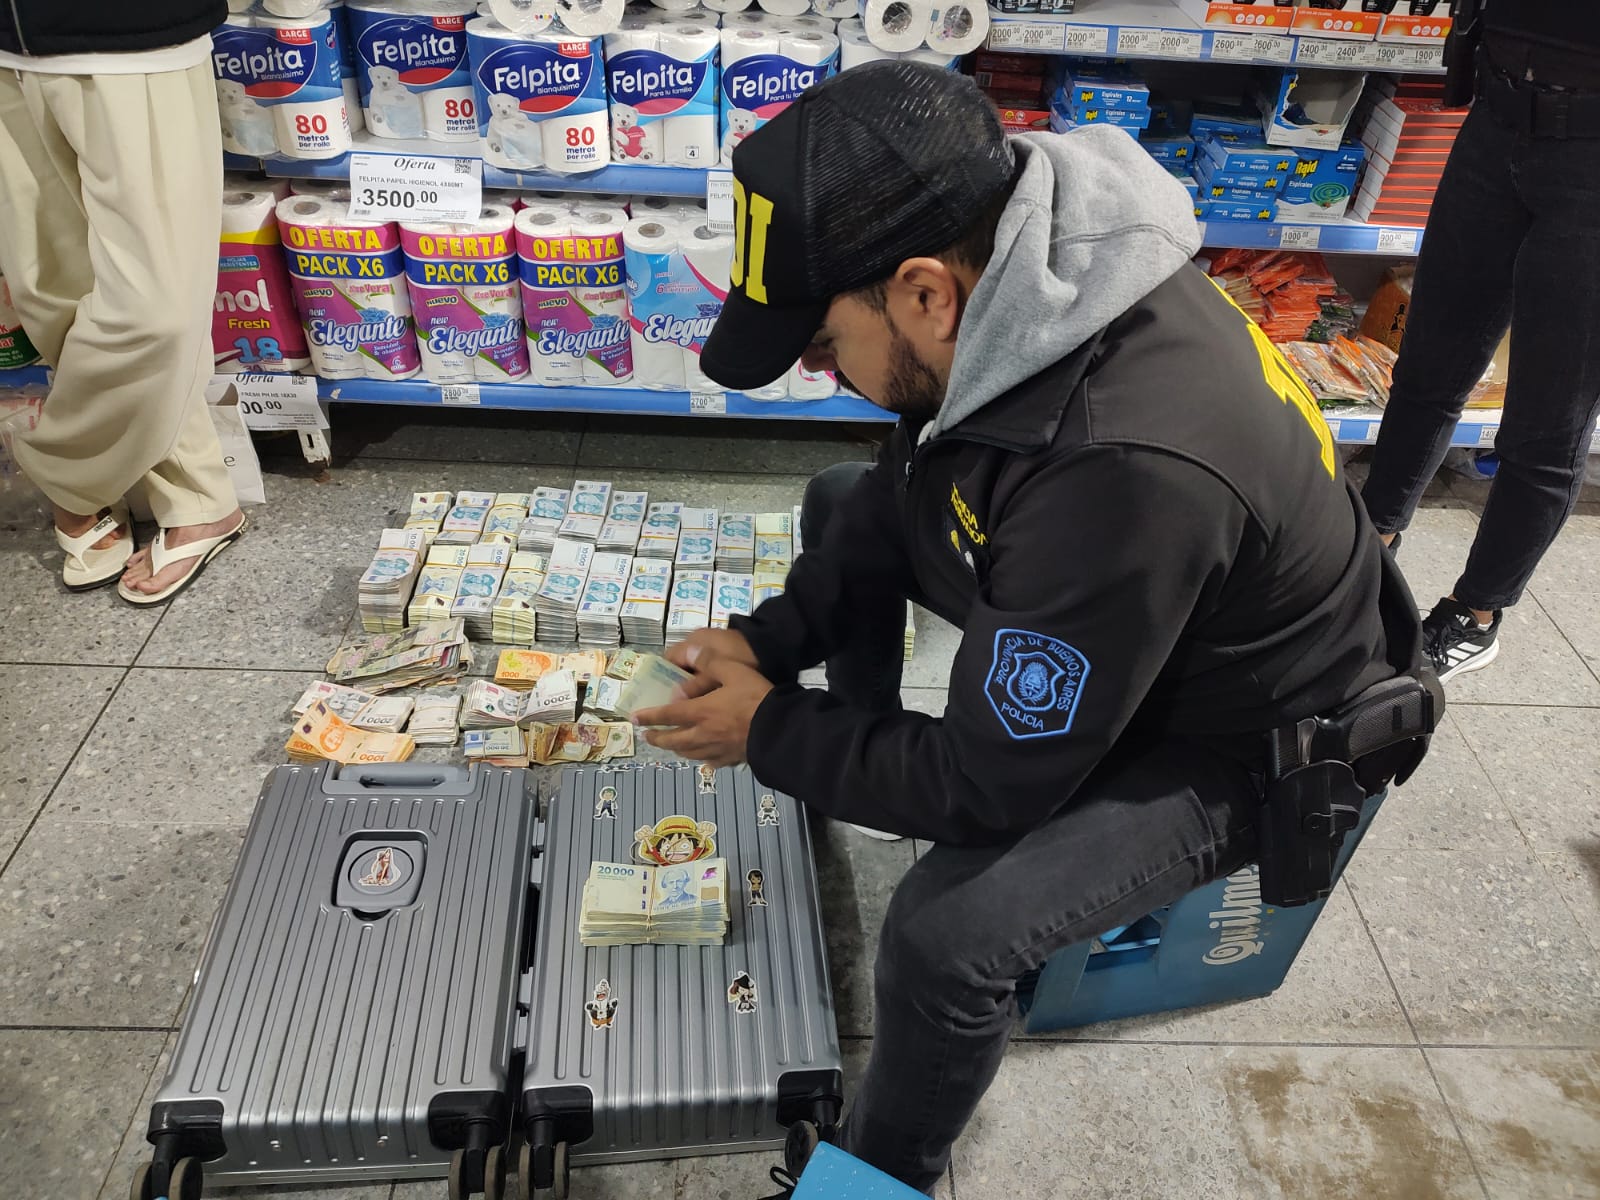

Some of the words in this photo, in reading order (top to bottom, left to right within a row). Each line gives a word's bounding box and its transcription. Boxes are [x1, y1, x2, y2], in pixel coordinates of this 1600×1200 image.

[436, 17, 461, 25] LARGE
[279, 30, 308, 38] LARGE
[372, 33, 457, 66] Felpita
[561, 43, 587, 51] LARGE
[214, 46, 305, 80] Felpita
[494, 60, 581, 94] Felpita
[612, 63, 694, 97] Felpita
[732, 67, 815, 101] Felpita
[445, 98, 474, 118] 80
[295, 114, 328, 135] 80
[446, 118, 475, 126] metros
[298, 134, 330, 142] metros
[566, 126, 595, 147] 80
[566, 146, 596, 154] metros
[689, 149, 696, 158] 4
[393, 157, 436, 171] Oferta
[1295, 160, 1319, 178] Raid
[359, 175, 385, 184] FELPITA
[386, 177, 408, 185] PAPEL
[1288, 180, 1313, 189] Espirales
[289, 226, 382, 250] OFERTA
[418, 234, 508, 257] OFERTA
[1284, 231, 1302, 241] 1000
[532, 236, 619, 259] OFERTA
[296, 254, 352, 276] PACK
[356, 257, 385, 277] X6
[424, 263, 478, 283] PACK
[483, 262, 509, 283] X6
[537, 265, 589, 286] PACK
[594, 264, 619, 285] X6
[227, 318, 271, 329] Fresh
[430, 316, 449, 325] new
[642, 313, 720, 347] Elegan
[309, 315, 408, 352] Elegante
[536, 320, 631, 358] Elegante
[233, 336, 283, 364] 18
[1027, 635, 1044, 647] DE
[994, 635, 1026, 687] PROVINCIA
[1047, 642, 1081, 678] BUENOS
[543, 694, 571, 706] 2000
[1056, 679, 1079, 712] AIRES
[1001, 701, 1044, 731] POLICIA
[359, 754, 385, 762] 1000
